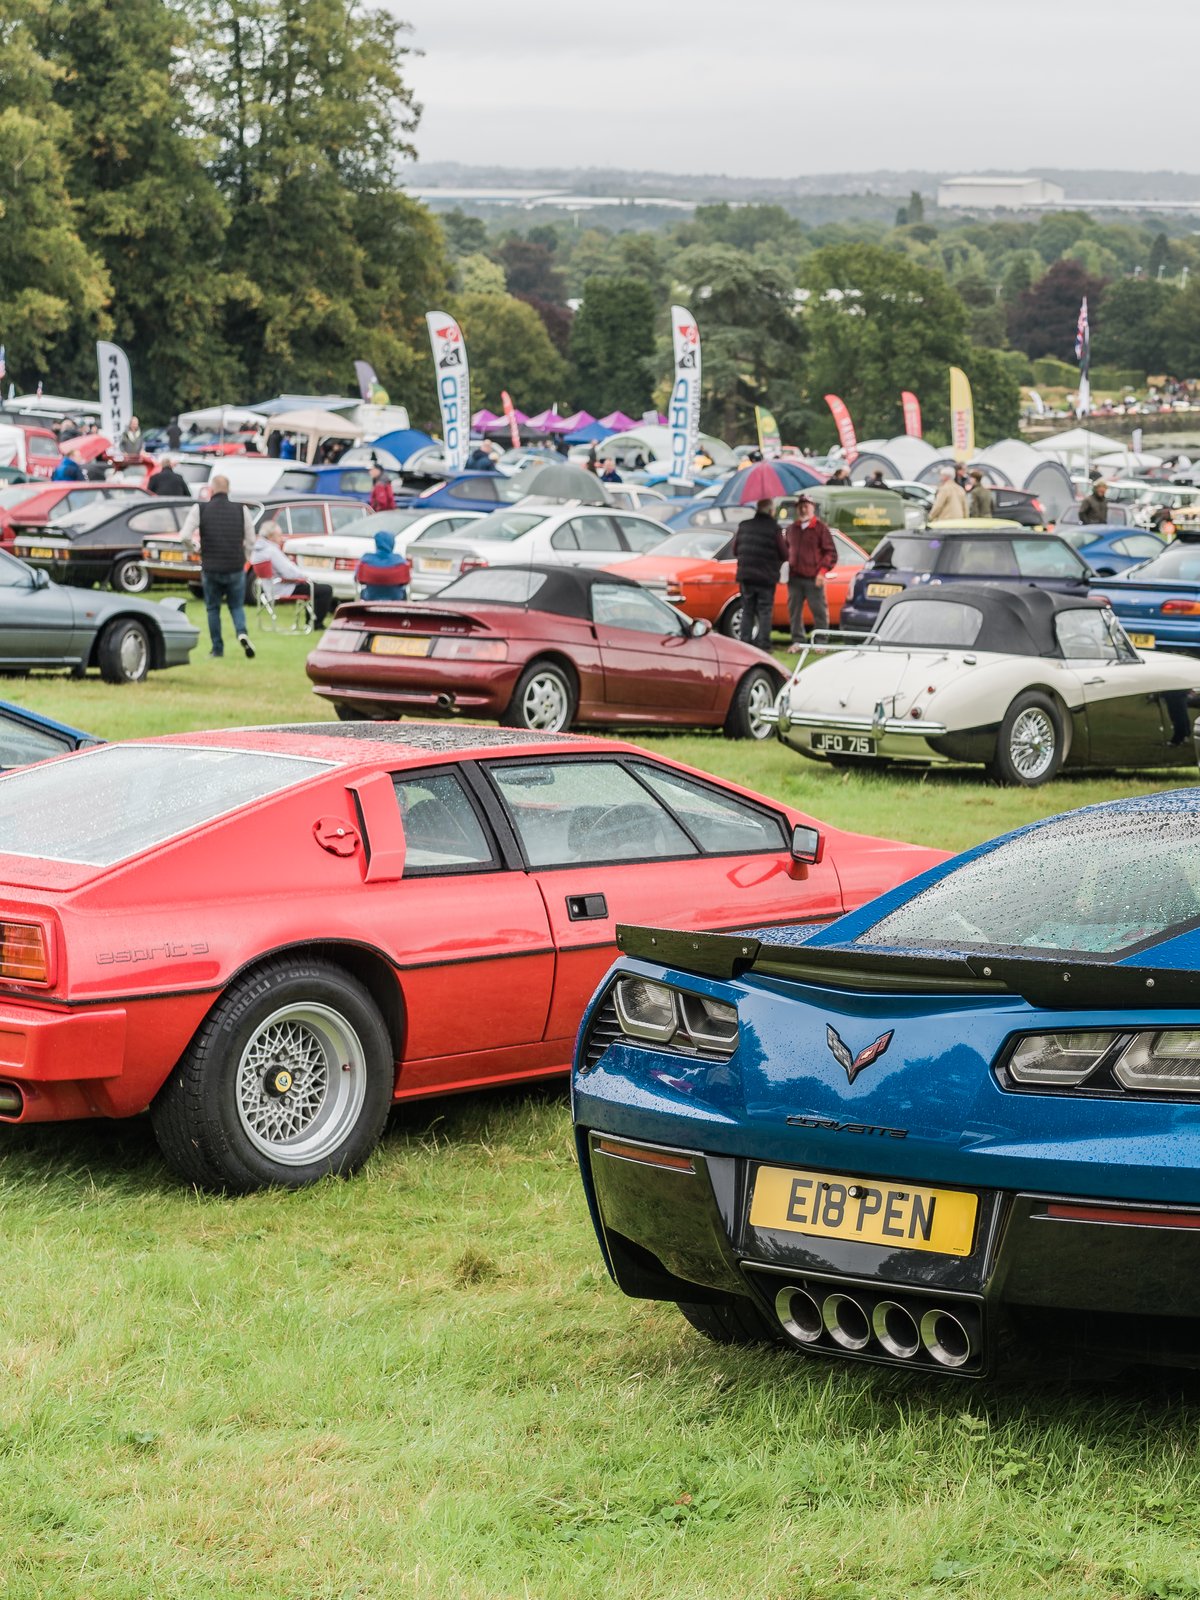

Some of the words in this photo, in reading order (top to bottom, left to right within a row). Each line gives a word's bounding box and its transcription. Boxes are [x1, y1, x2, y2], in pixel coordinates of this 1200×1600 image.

[817, 734, 843, 750] JFO
[848, 736, 869, 753] 715
[222, 980, 271, 1032] PIRELLI
[786, 1115, 909, 1138] CORVETTE
[786, 1178, 847, 1228] E18
[856, 1187, 936, 1242] PEN
